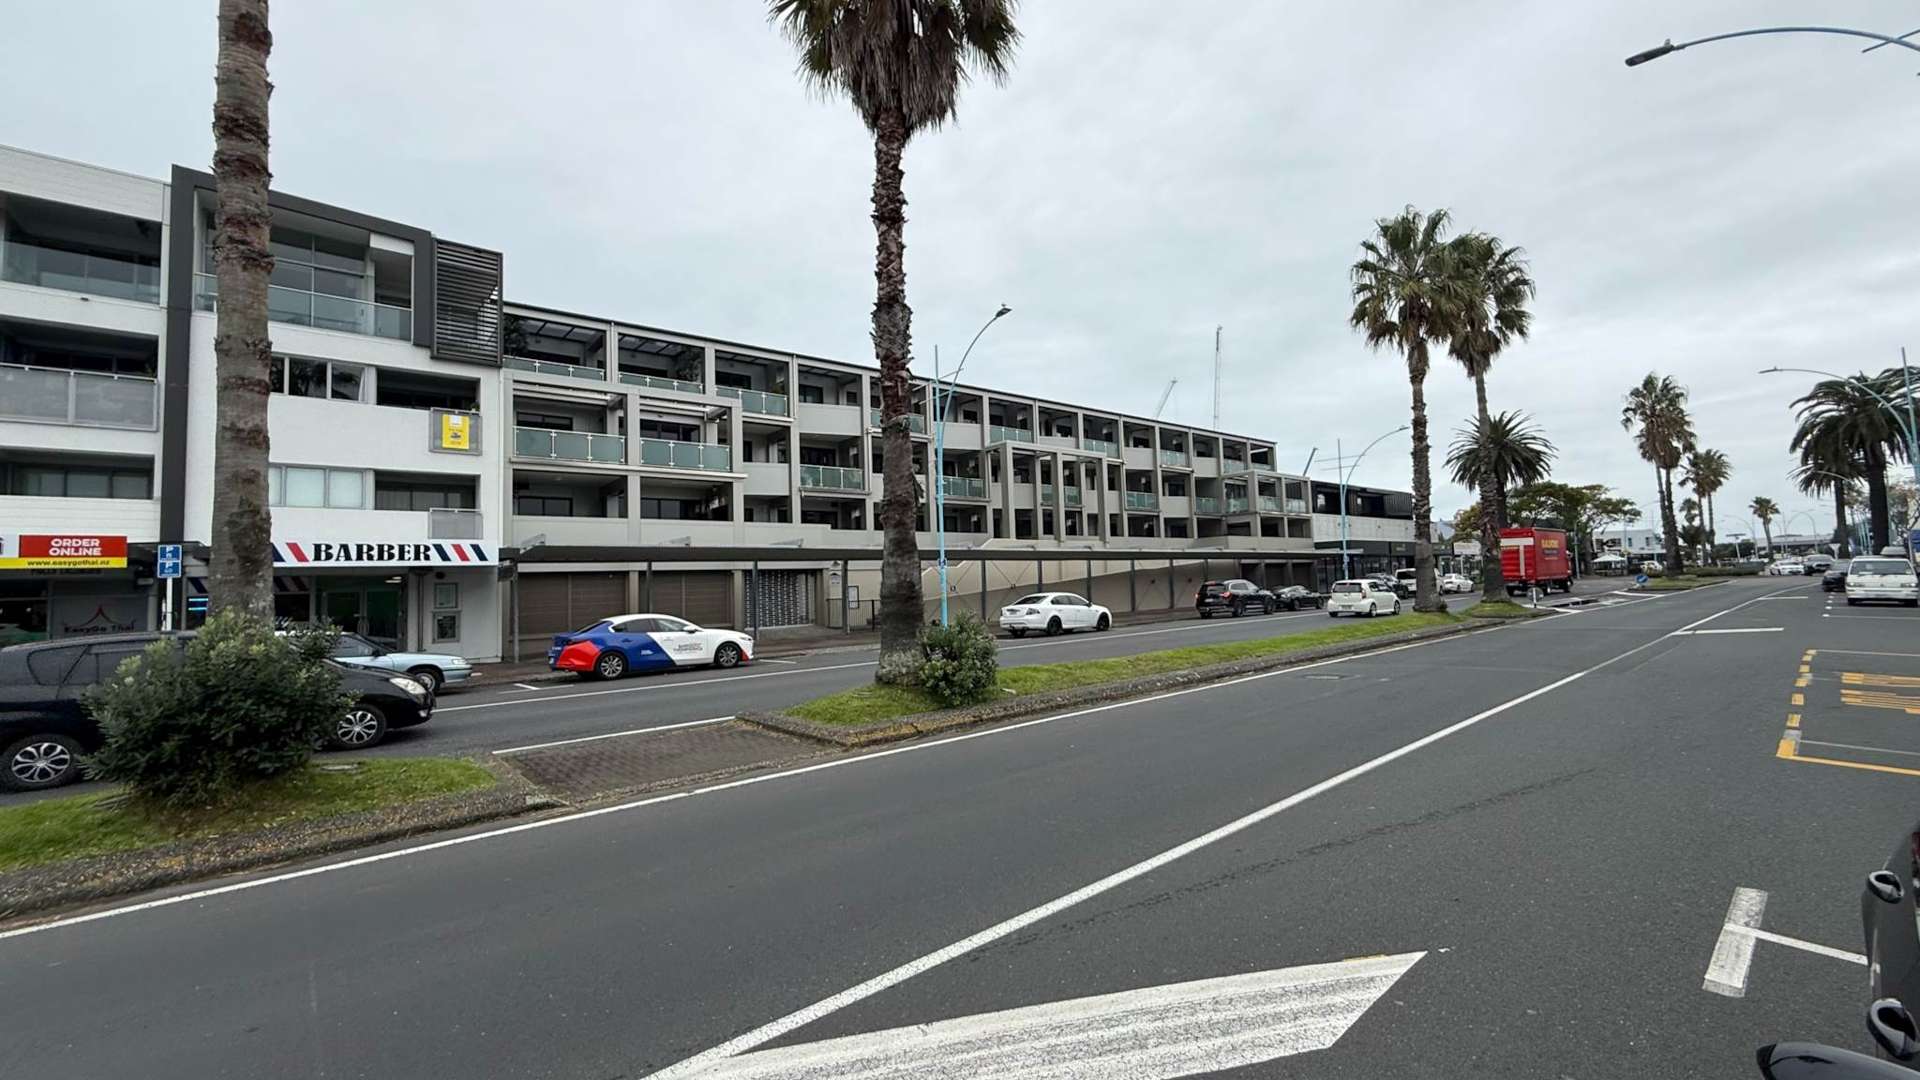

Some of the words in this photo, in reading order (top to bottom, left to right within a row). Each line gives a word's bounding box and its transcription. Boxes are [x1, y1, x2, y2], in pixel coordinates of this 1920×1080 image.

[50, 538, 100, 547] ORDER
[48, 547, 102, 556] ONLINE
[312, 543, 431, 562] BARBER
